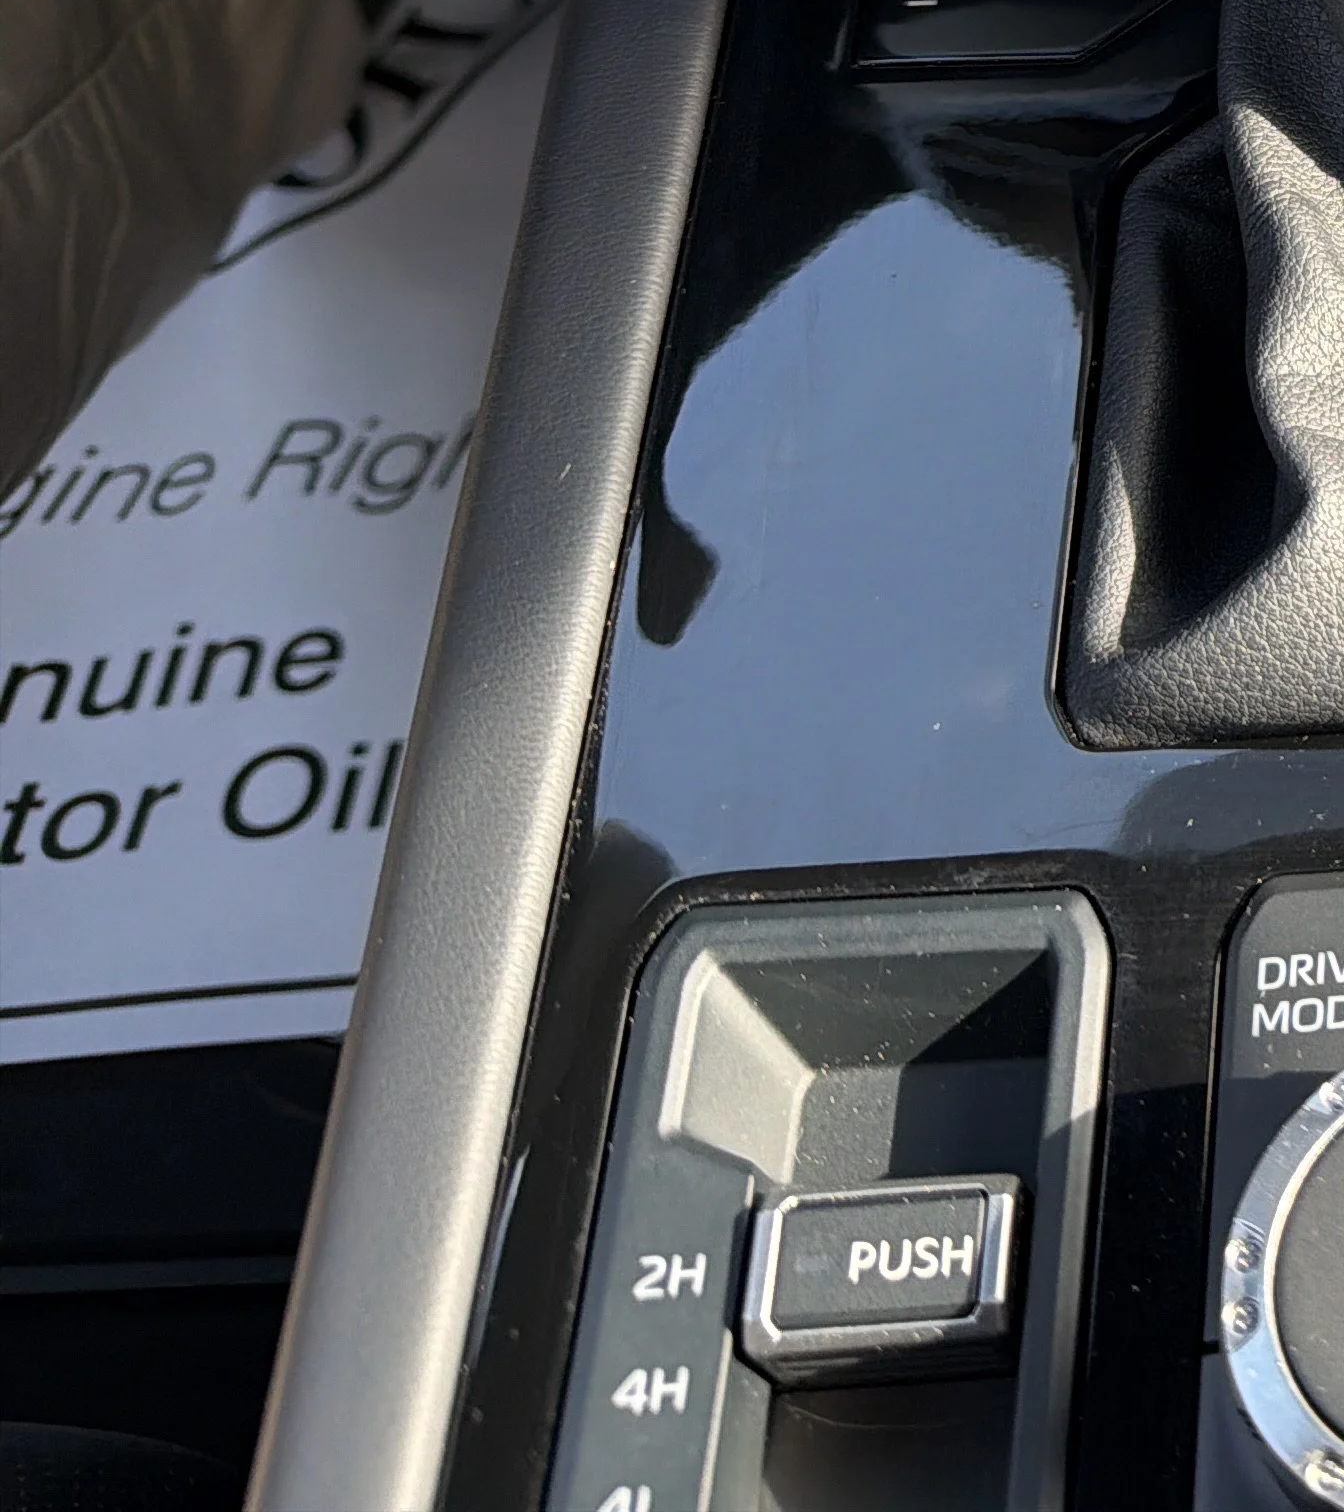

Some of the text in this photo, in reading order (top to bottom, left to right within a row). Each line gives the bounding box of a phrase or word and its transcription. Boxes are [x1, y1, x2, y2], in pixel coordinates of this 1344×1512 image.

[0, 621, 346, 725] nuine
[222, 737, 404, 840] Oil
[631, 1251, 708, 1303] 2H
[848, 1233, 975, 1285] PUSH
[611, 1365, 690, 1417] 4H
